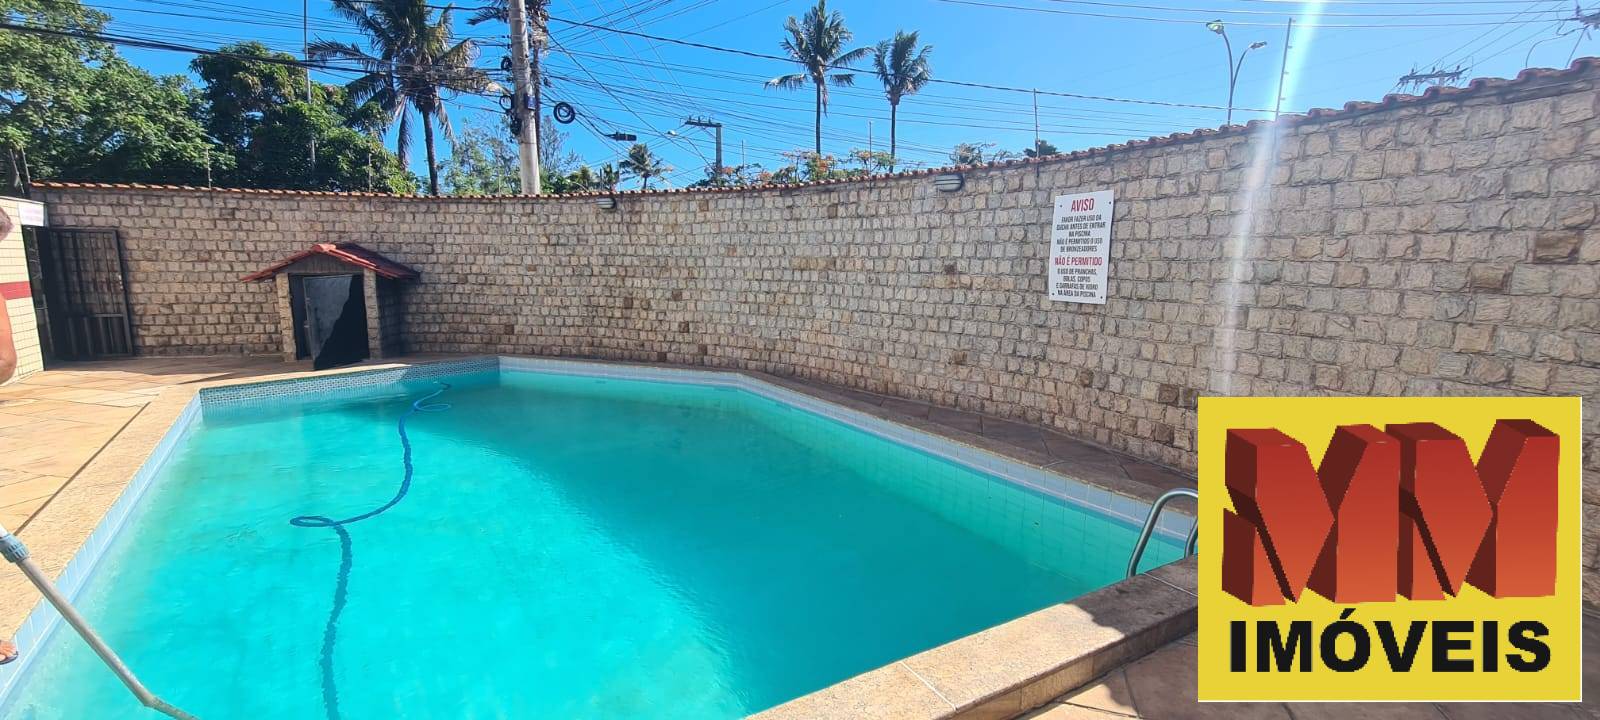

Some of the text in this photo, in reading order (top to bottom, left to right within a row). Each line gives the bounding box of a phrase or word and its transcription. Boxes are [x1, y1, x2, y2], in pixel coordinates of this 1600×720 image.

[1071, 198, 1094, 212] AVISO
[1055, 255, 1102, 266] NÃO É PERMITIDO
